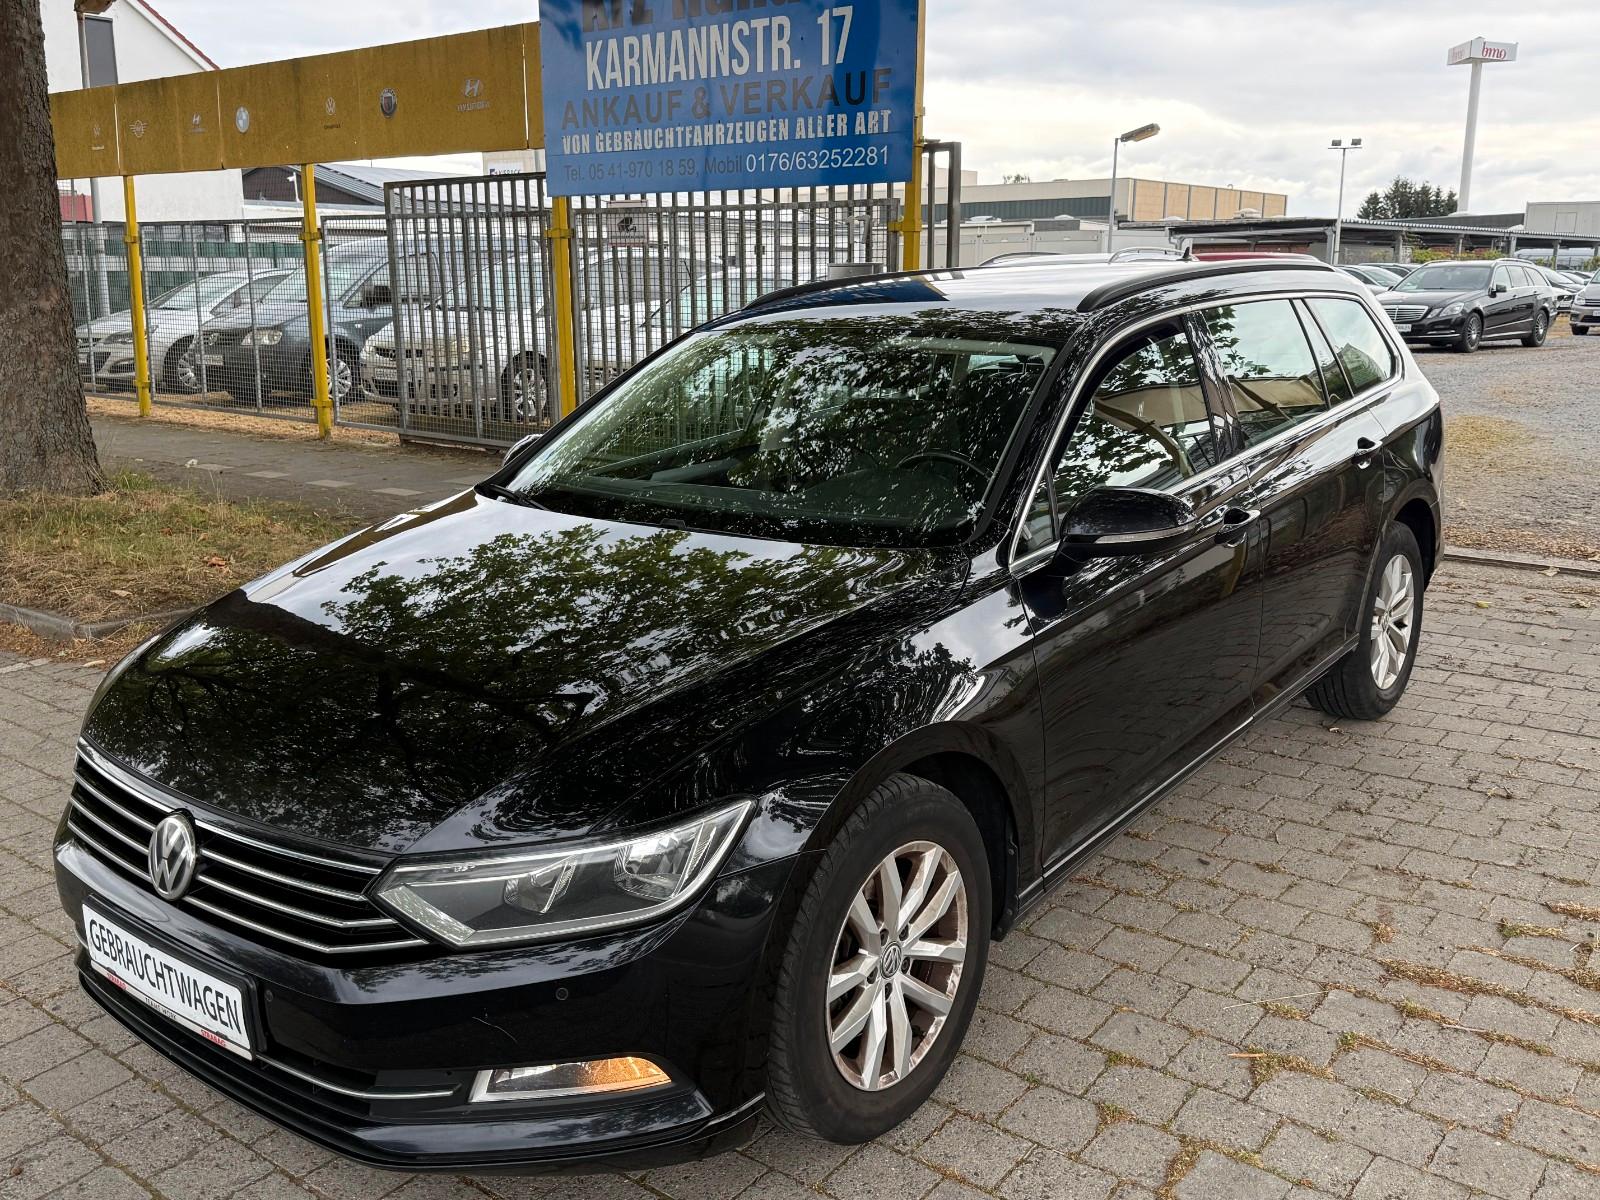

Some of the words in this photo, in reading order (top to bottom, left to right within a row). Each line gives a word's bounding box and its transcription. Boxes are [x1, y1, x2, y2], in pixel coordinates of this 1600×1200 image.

[585, 15, 801, 91] KARMANNSTR.
[816, 5, 853, 66] 17
[561, 89, 683, 130] ANKAUF
[691, 86, 712, 120] &
[720, 67, 892, 117] VERKAUF
[562, 133, 590, 155] VON
[595, 117, 789, 153] GEBRAUCHTFAHRZEUGEN
[794, 113, 848, 140] ALLER
[854, 109, 892, 136] ART
[564, 164, 585, 182] Tel.
[659, 159, 674, 176] 18
[704, 154, 743, 175] Mobil
[745, 145, 889, 173] 0176/63252281
[88, 919, 242, 1035] GEBRAUCHTWAGEN
